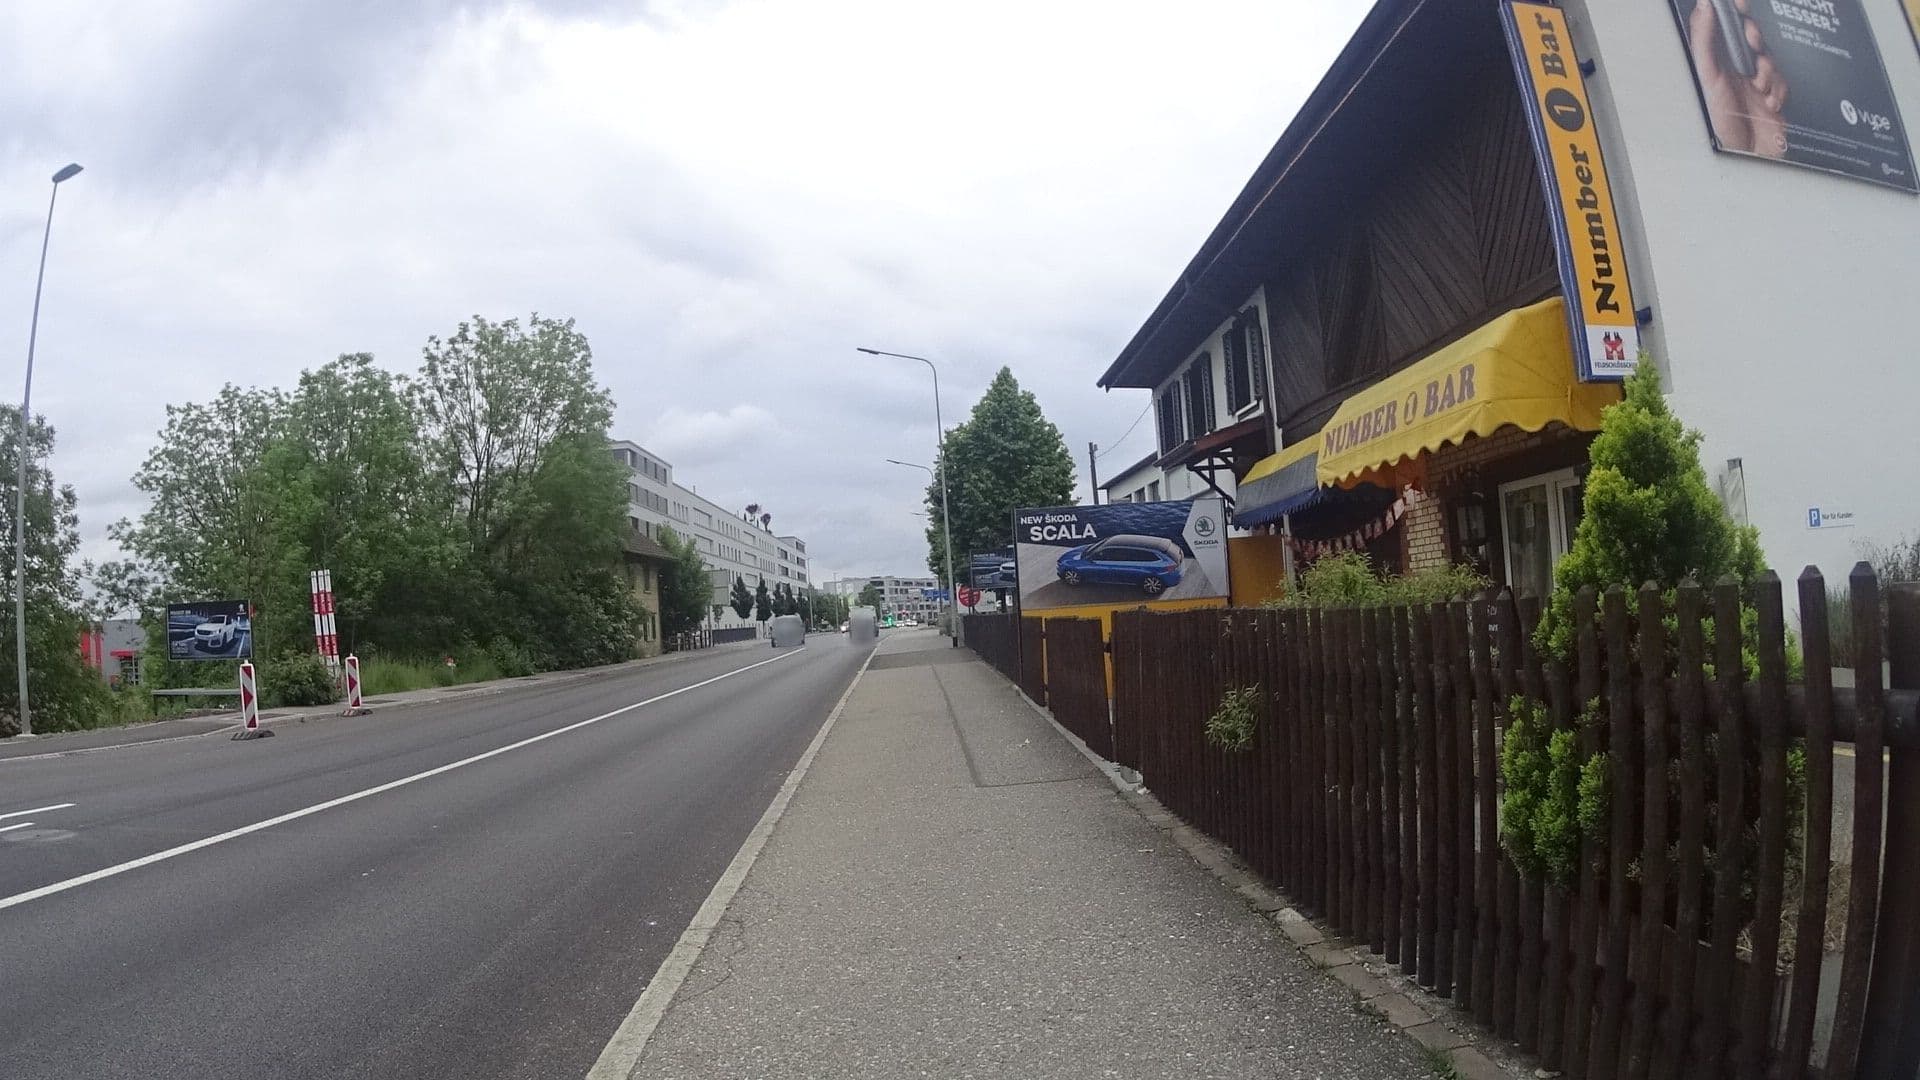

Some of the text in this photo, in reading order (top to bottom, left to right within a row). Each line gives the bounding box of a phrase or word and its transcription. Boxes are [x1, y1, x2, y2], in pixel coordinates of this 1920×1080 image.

[1534, 12, 1568, 79] Bar
[1569, 143, 1620, 314] Number
[1322, 400, 1398, 459] NUMBER
[1423, 363, 1475, 418] BAR
[1020, 516, 1043, 525] NEW
[1030, 523, 1097, 542] SCALA
